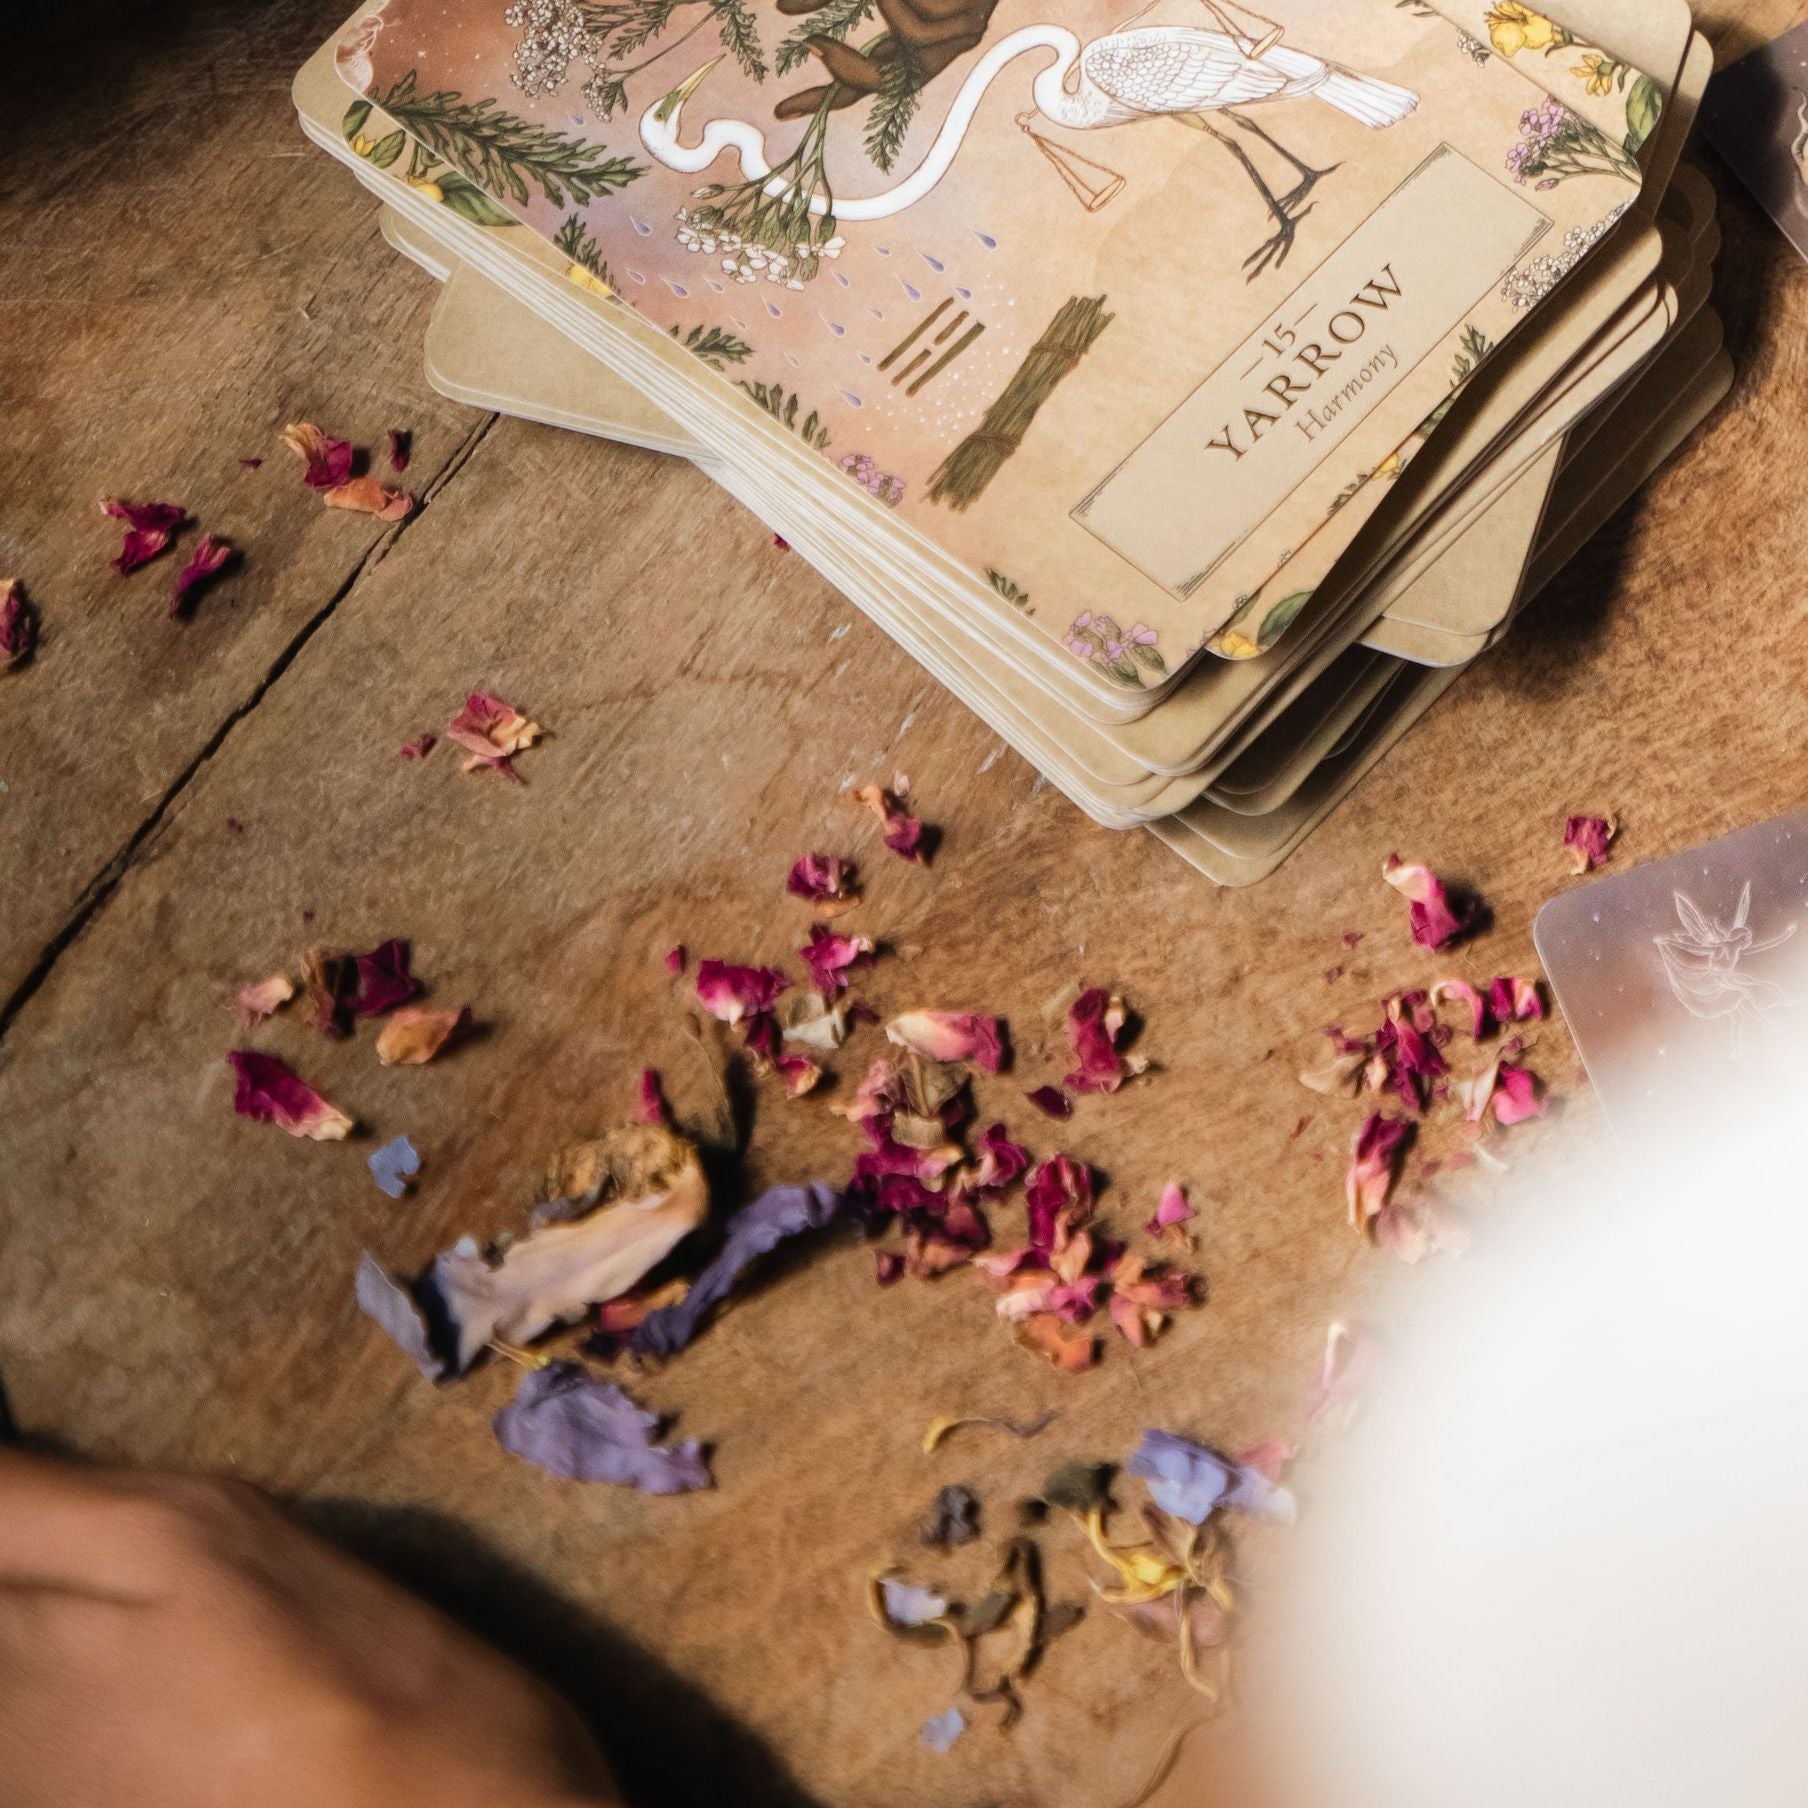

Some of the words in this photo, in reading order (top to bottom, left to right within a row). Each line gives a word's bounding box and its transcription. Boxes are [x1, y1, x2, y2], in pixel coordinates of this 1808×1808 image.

[1204, 263, 1402, 461] YARROW
[1261, 322, 1298, 359] 15
[1294, 344, 1398, 442] Harmony
